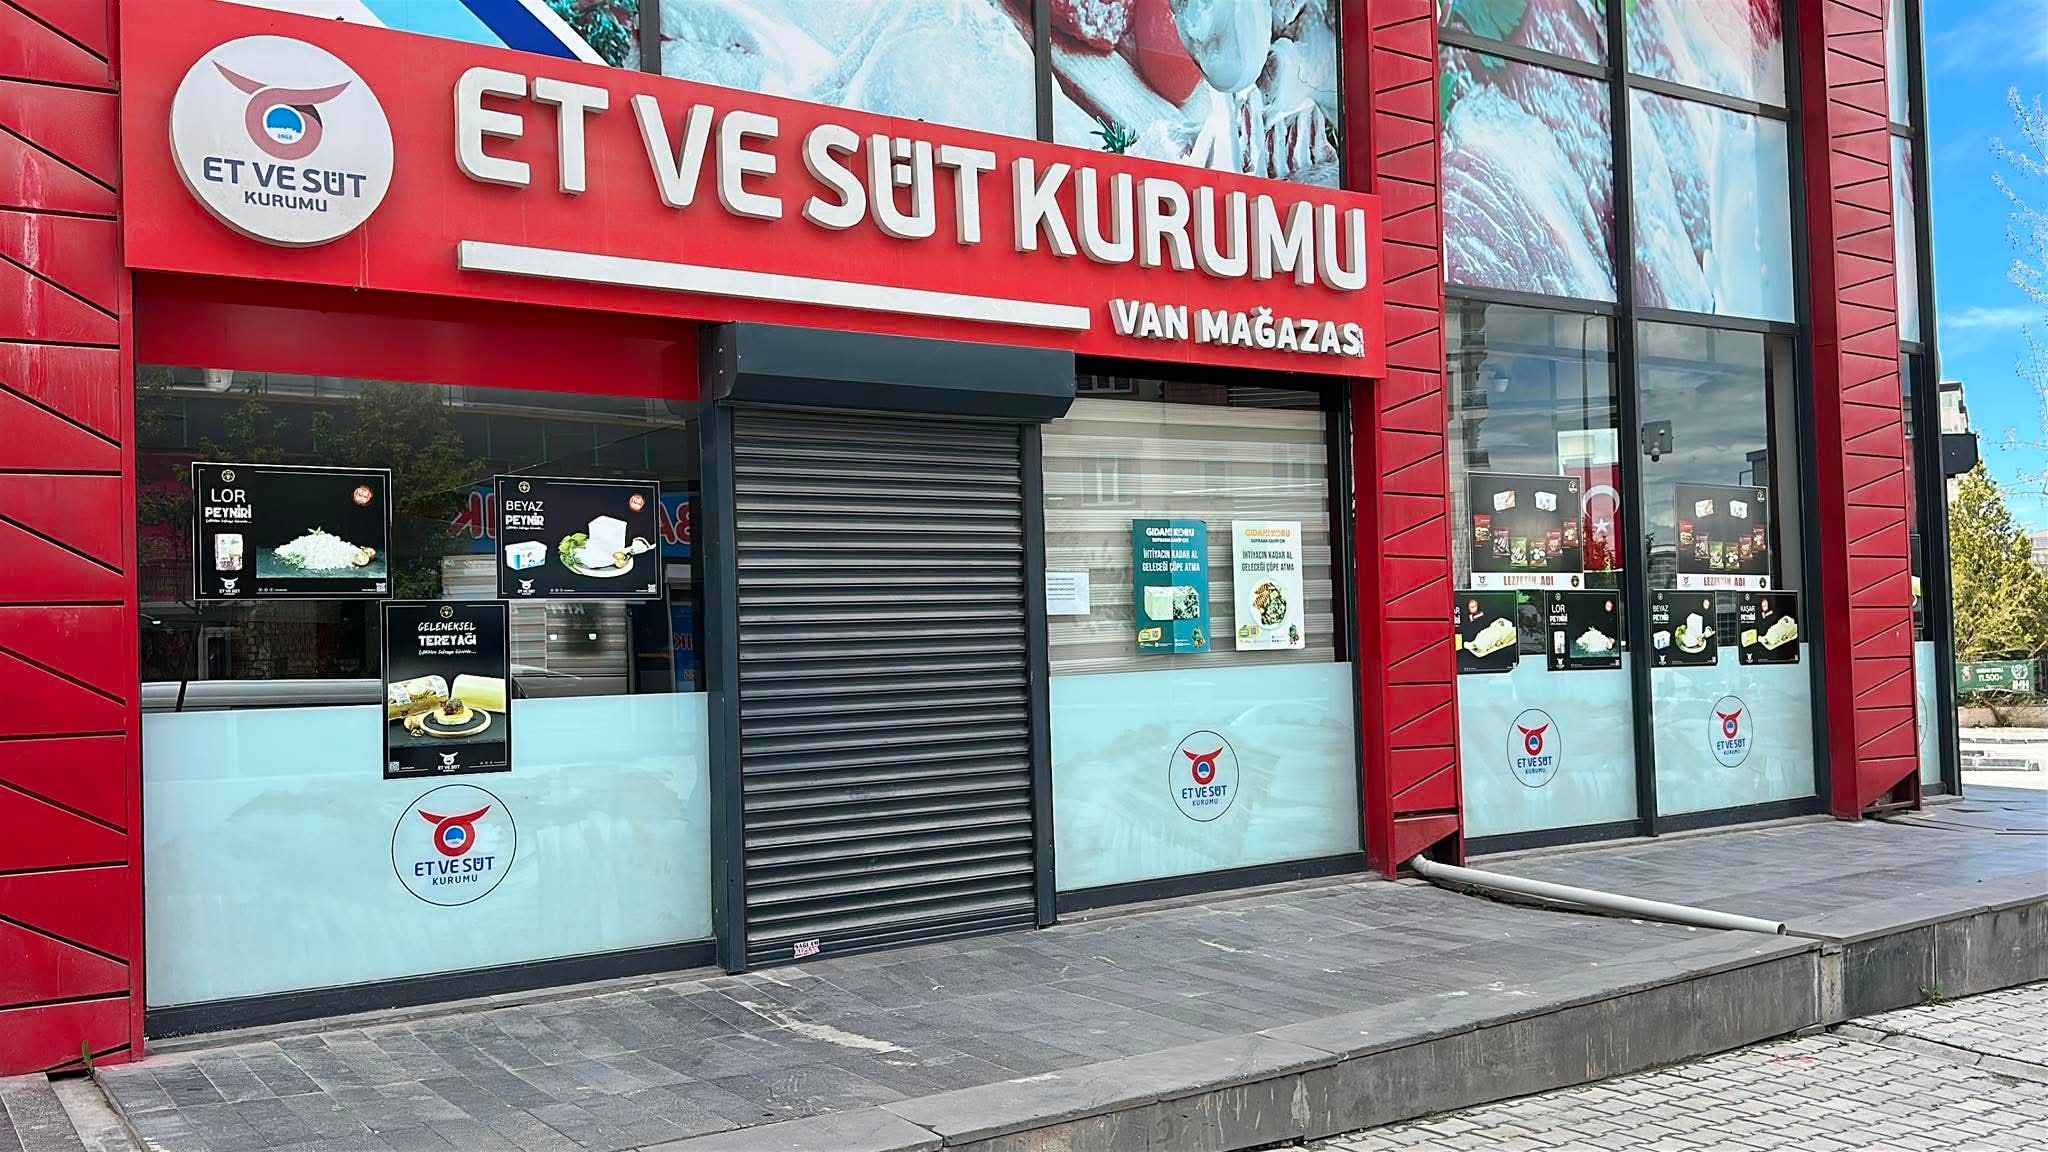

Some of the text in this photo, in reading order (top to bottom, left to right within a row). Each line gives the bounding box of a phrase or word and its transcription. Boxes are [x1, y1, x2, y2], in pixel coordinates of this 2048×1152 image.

[203, 156, 367, 198] ET VE SÜT
[454, 66, 1367, 291] ET VE SÜT KURUMU
[245, 191, 328, 212] KURUMU
[1109, 298, 1189, 342] VAN
[211, 488, 246, 503] LOR
[205, 504, 252, 518] PEYNİRİ
[506, 500, 543, 511] BEYAZ
[505, 512, 544, 525] PEYNİR
[1540, 575, 1554, 586] ADI
[1551, 604, 1565, 613] LOR
[418, 621, 476, 631] GELENEKSEL
[418, 632, 477, 646] TEREYAĞI
[1717, 741, 1724, 751] ET
[1725, 740, 1733, 750] VE
[1517, 758, 1526, 768] ET
[1527, 757, 1536, 768] VE
[1182, 785, 1227, 799] ET VE SÜT
[414, 856, 495, 877] ET VE SÜT
[432, 874, 478, 886] KURUMU
